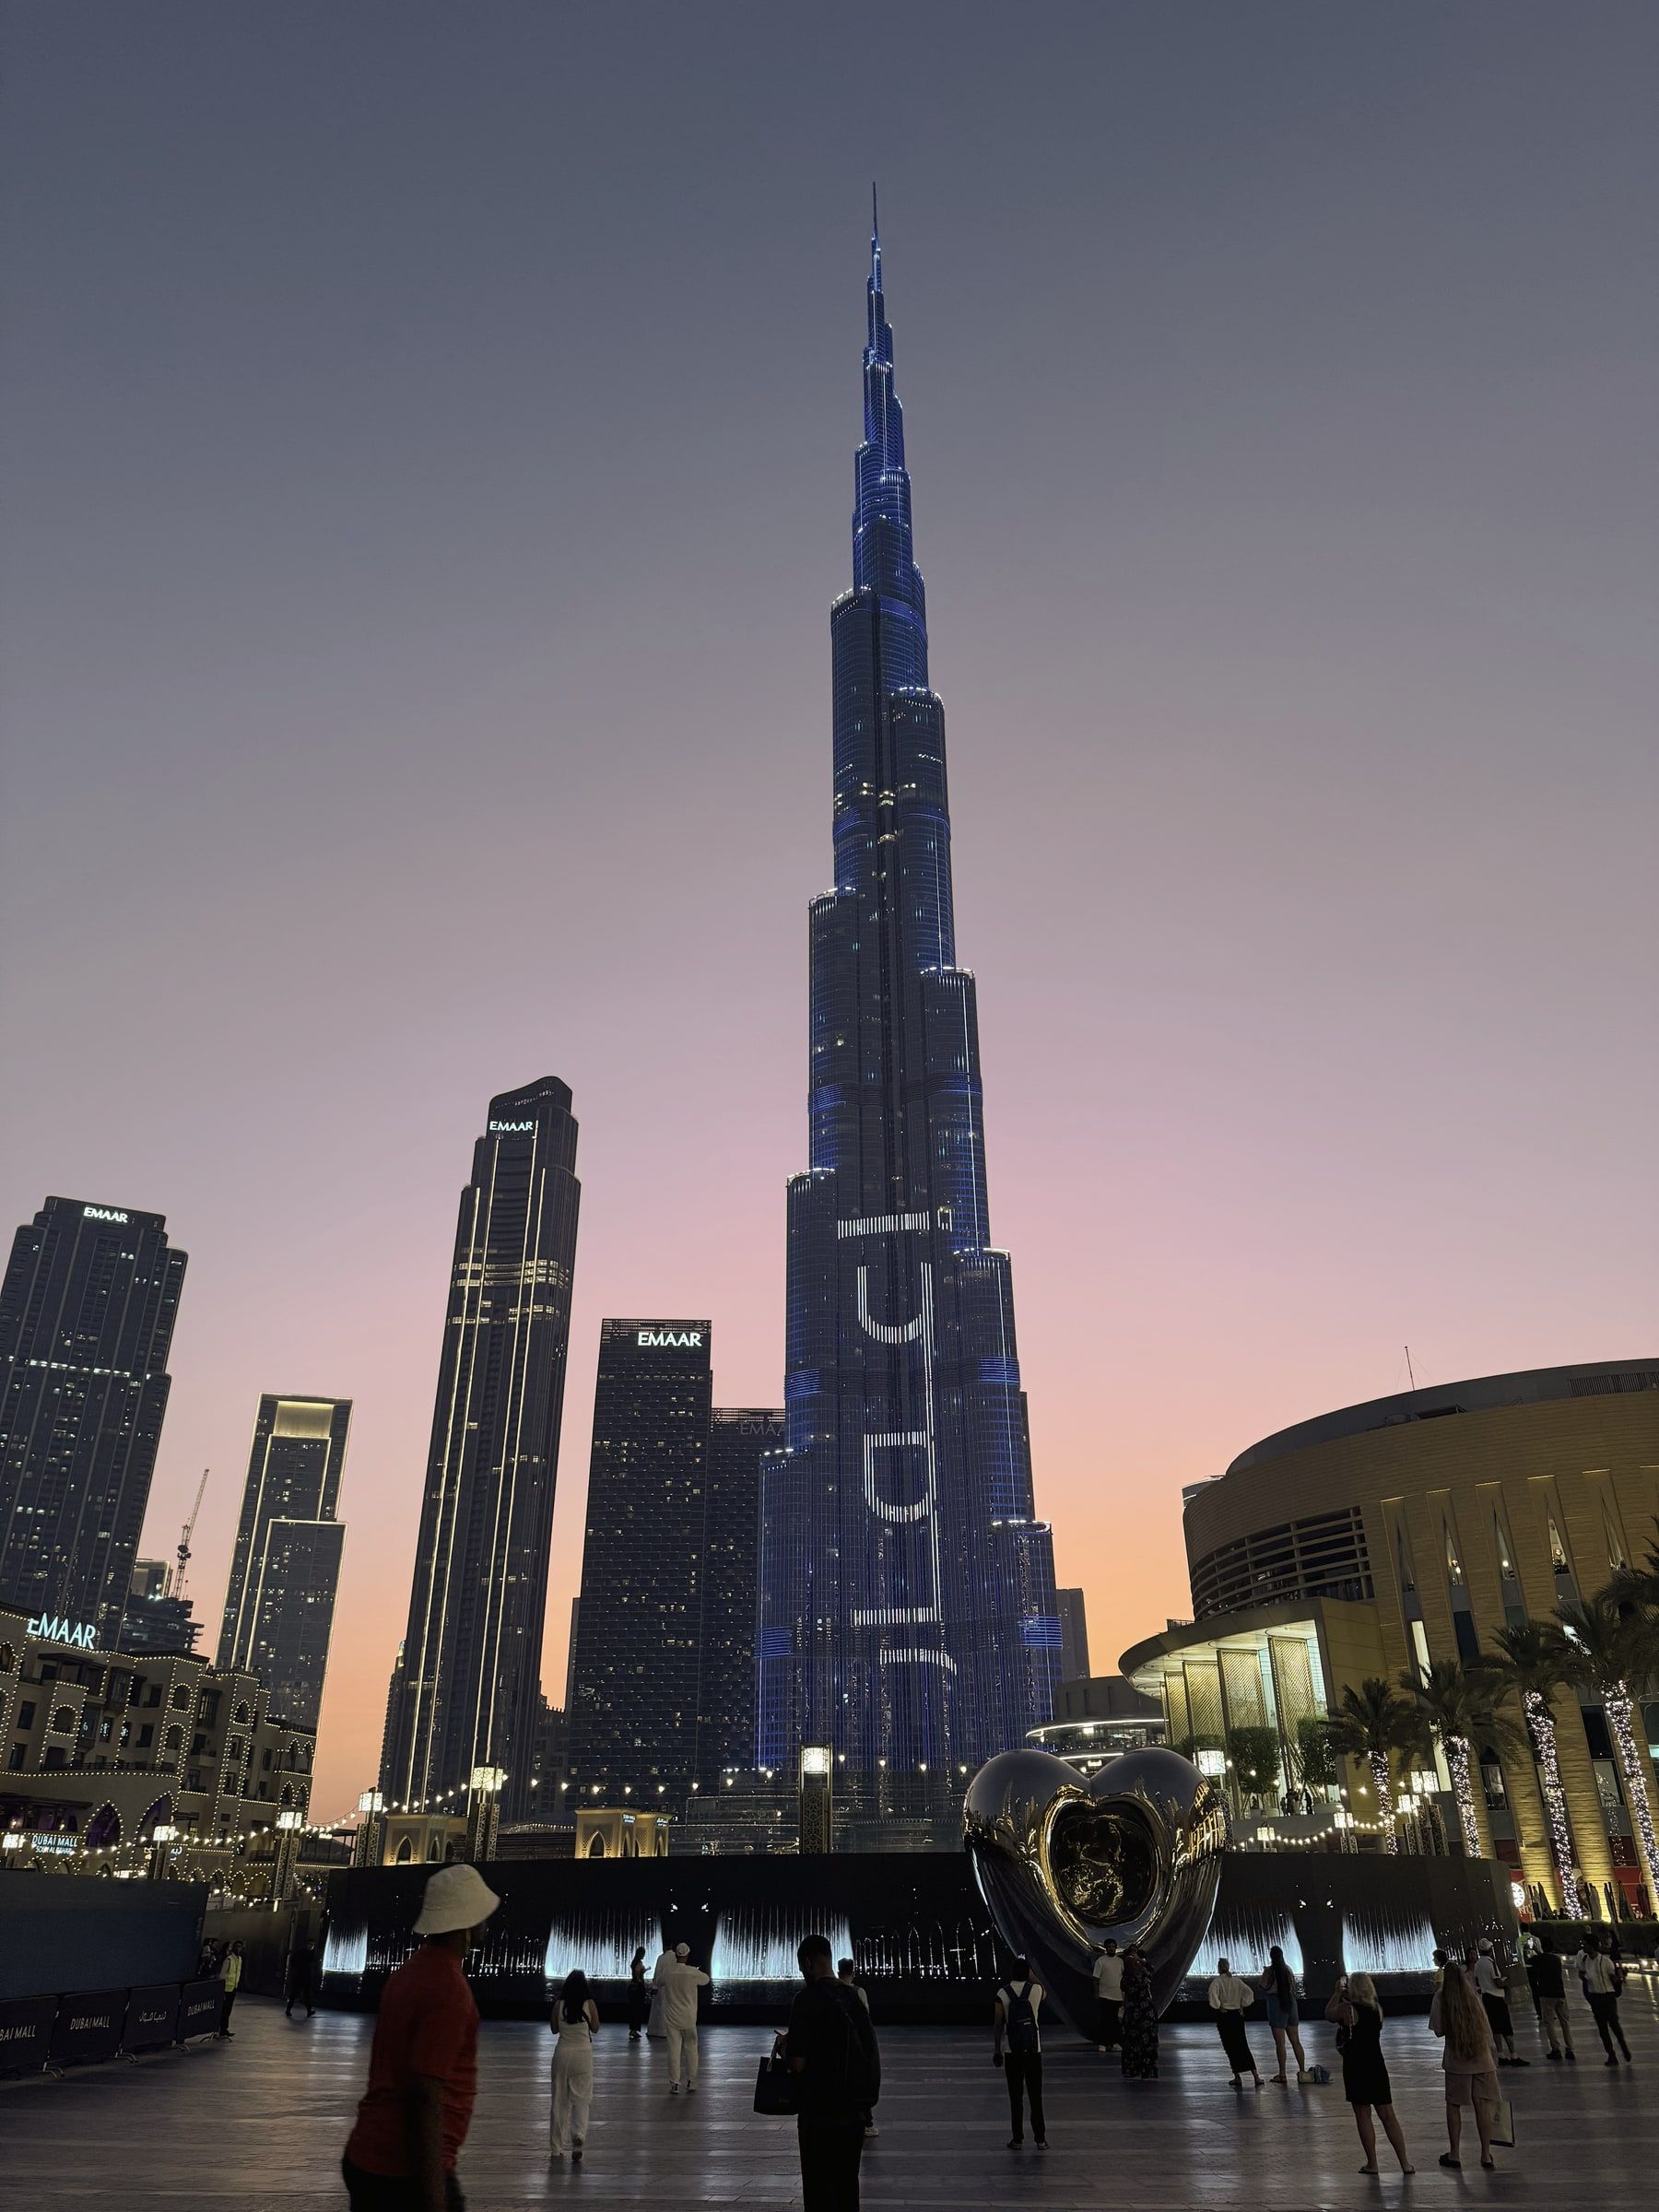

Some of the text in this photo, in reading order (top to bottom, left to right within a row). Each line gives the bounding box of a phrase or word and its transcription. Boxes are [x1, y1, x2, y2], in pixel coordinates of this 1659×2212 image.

[489, 1121, 534, 1131] EMAAR
[83, 1206, 128, 1224] EMAAR
[638, 1332, 702, 1347] EMAAR
[740, 1422, 785, 1435] EMAA
[26, 1612, 97, 1650] EMAAR
[31, 1835, 78, 1847] DUBAI MALL
[70, 2016, 110, 2030] DUBAI MALL
[0, 2025, 36, 2041] BAI MALL
